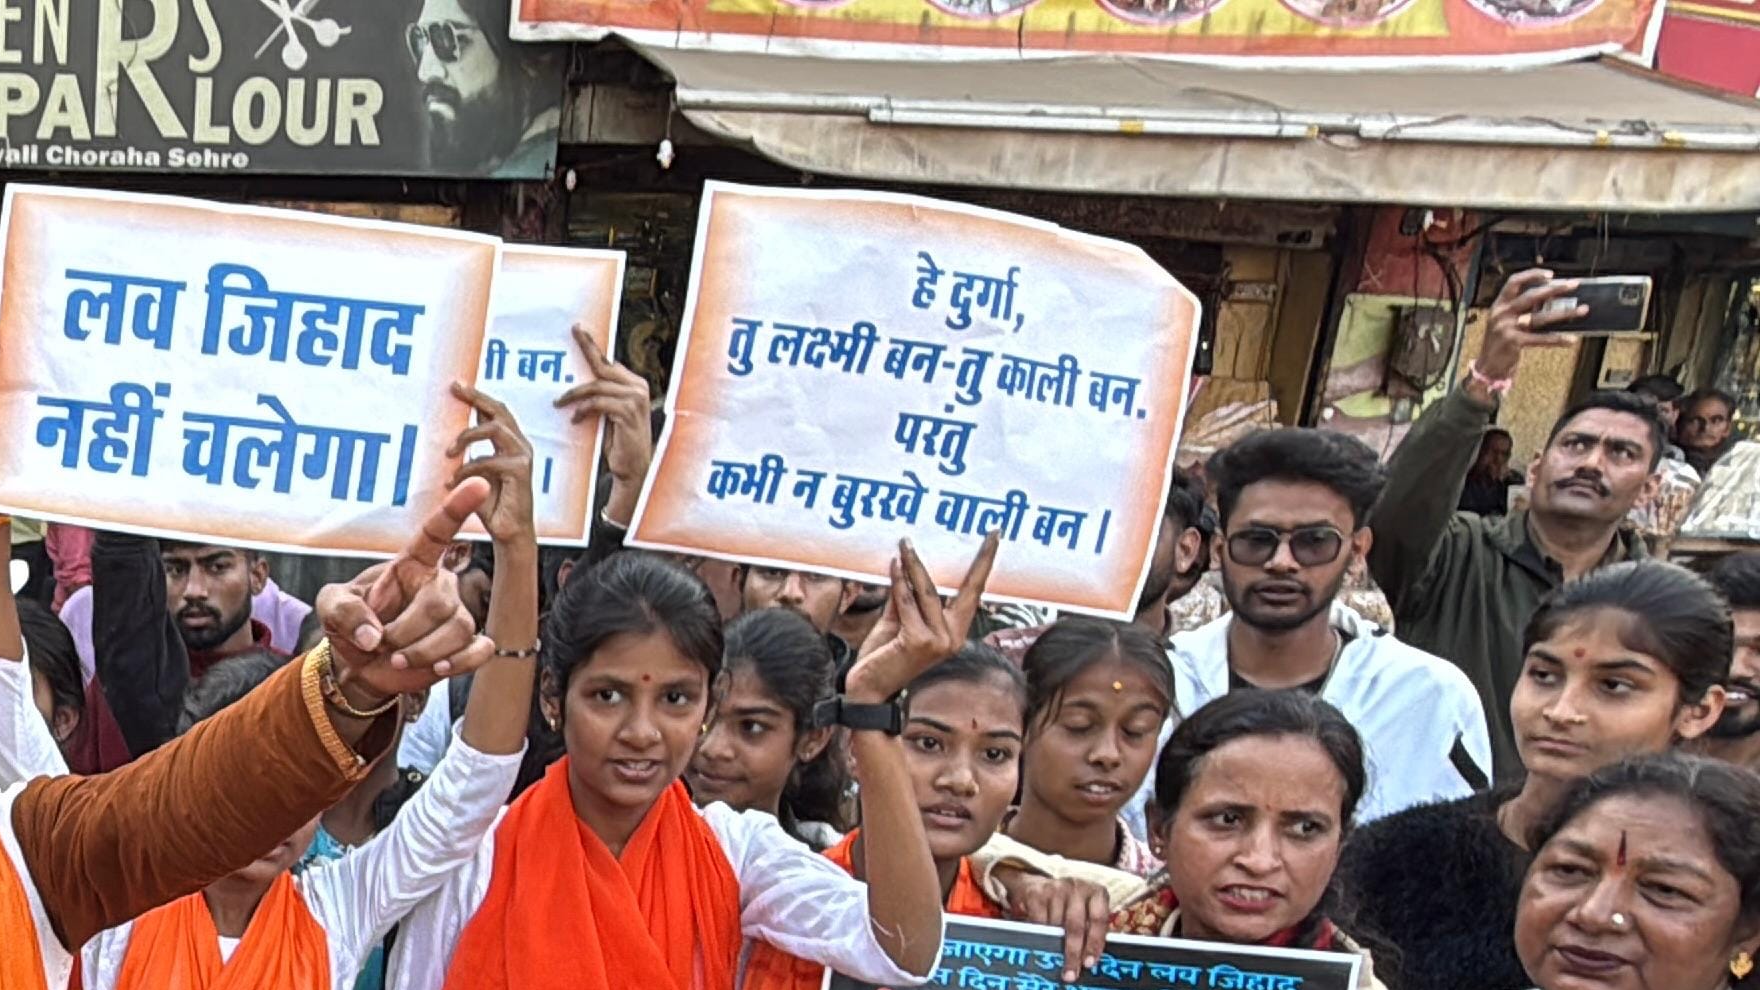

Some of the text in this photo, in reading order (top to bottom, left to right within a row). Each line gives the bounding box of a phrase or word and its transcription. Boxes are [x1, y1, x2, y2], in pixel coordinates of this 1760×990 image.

[46, 144, 161, 169] Choraha
[62, 268, 187, 350] लव
[200, 263, 426, 376] जिहाद
[911, 251, 1026, 333] हे दुर्गा,
[517, 349, 574, 383] बन.
[727, 317, 763, 376] तु
[768, 321, 880, 375] लक्ष्मी
[997, 353, 1080, 408] काली
[1089, 371, 1147, 420] बन.
[36, 382, 418, 507] नहीं चलेगा।
[894, 404, 978, 476] परंतु
[706, 453, 787, 504] कभी
[793, 468, 827, 508] न
[934, 489, 1029, 541] वाली
